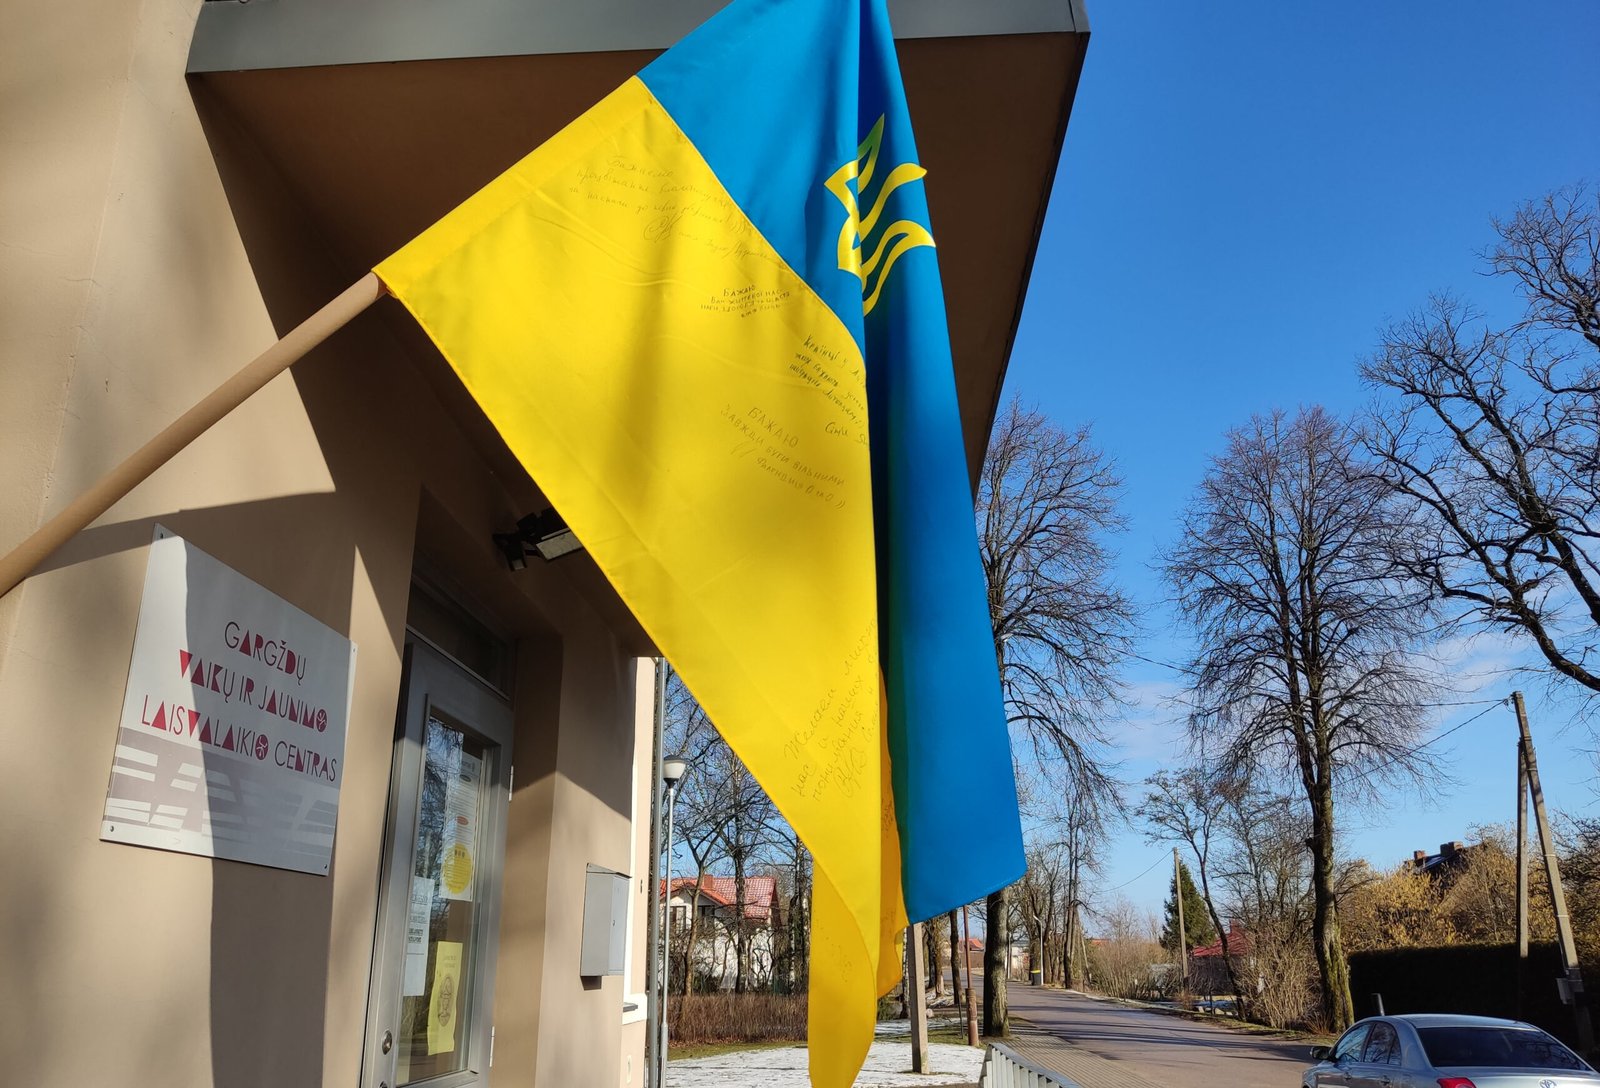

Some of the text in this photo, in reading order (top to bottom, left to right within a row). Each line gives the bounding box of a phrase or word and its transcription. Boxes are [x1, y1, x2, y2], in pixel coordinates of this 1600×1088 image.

[747, 406, 800, 449] БАЖАЮ
[179, 648, 328, 733] VAIKŲ IR JAUNIMO
[224, 621, 307, 686] GARGŽDŲ
[141, 694, 338, 782] LAISVALAIKIO CENTRAS
